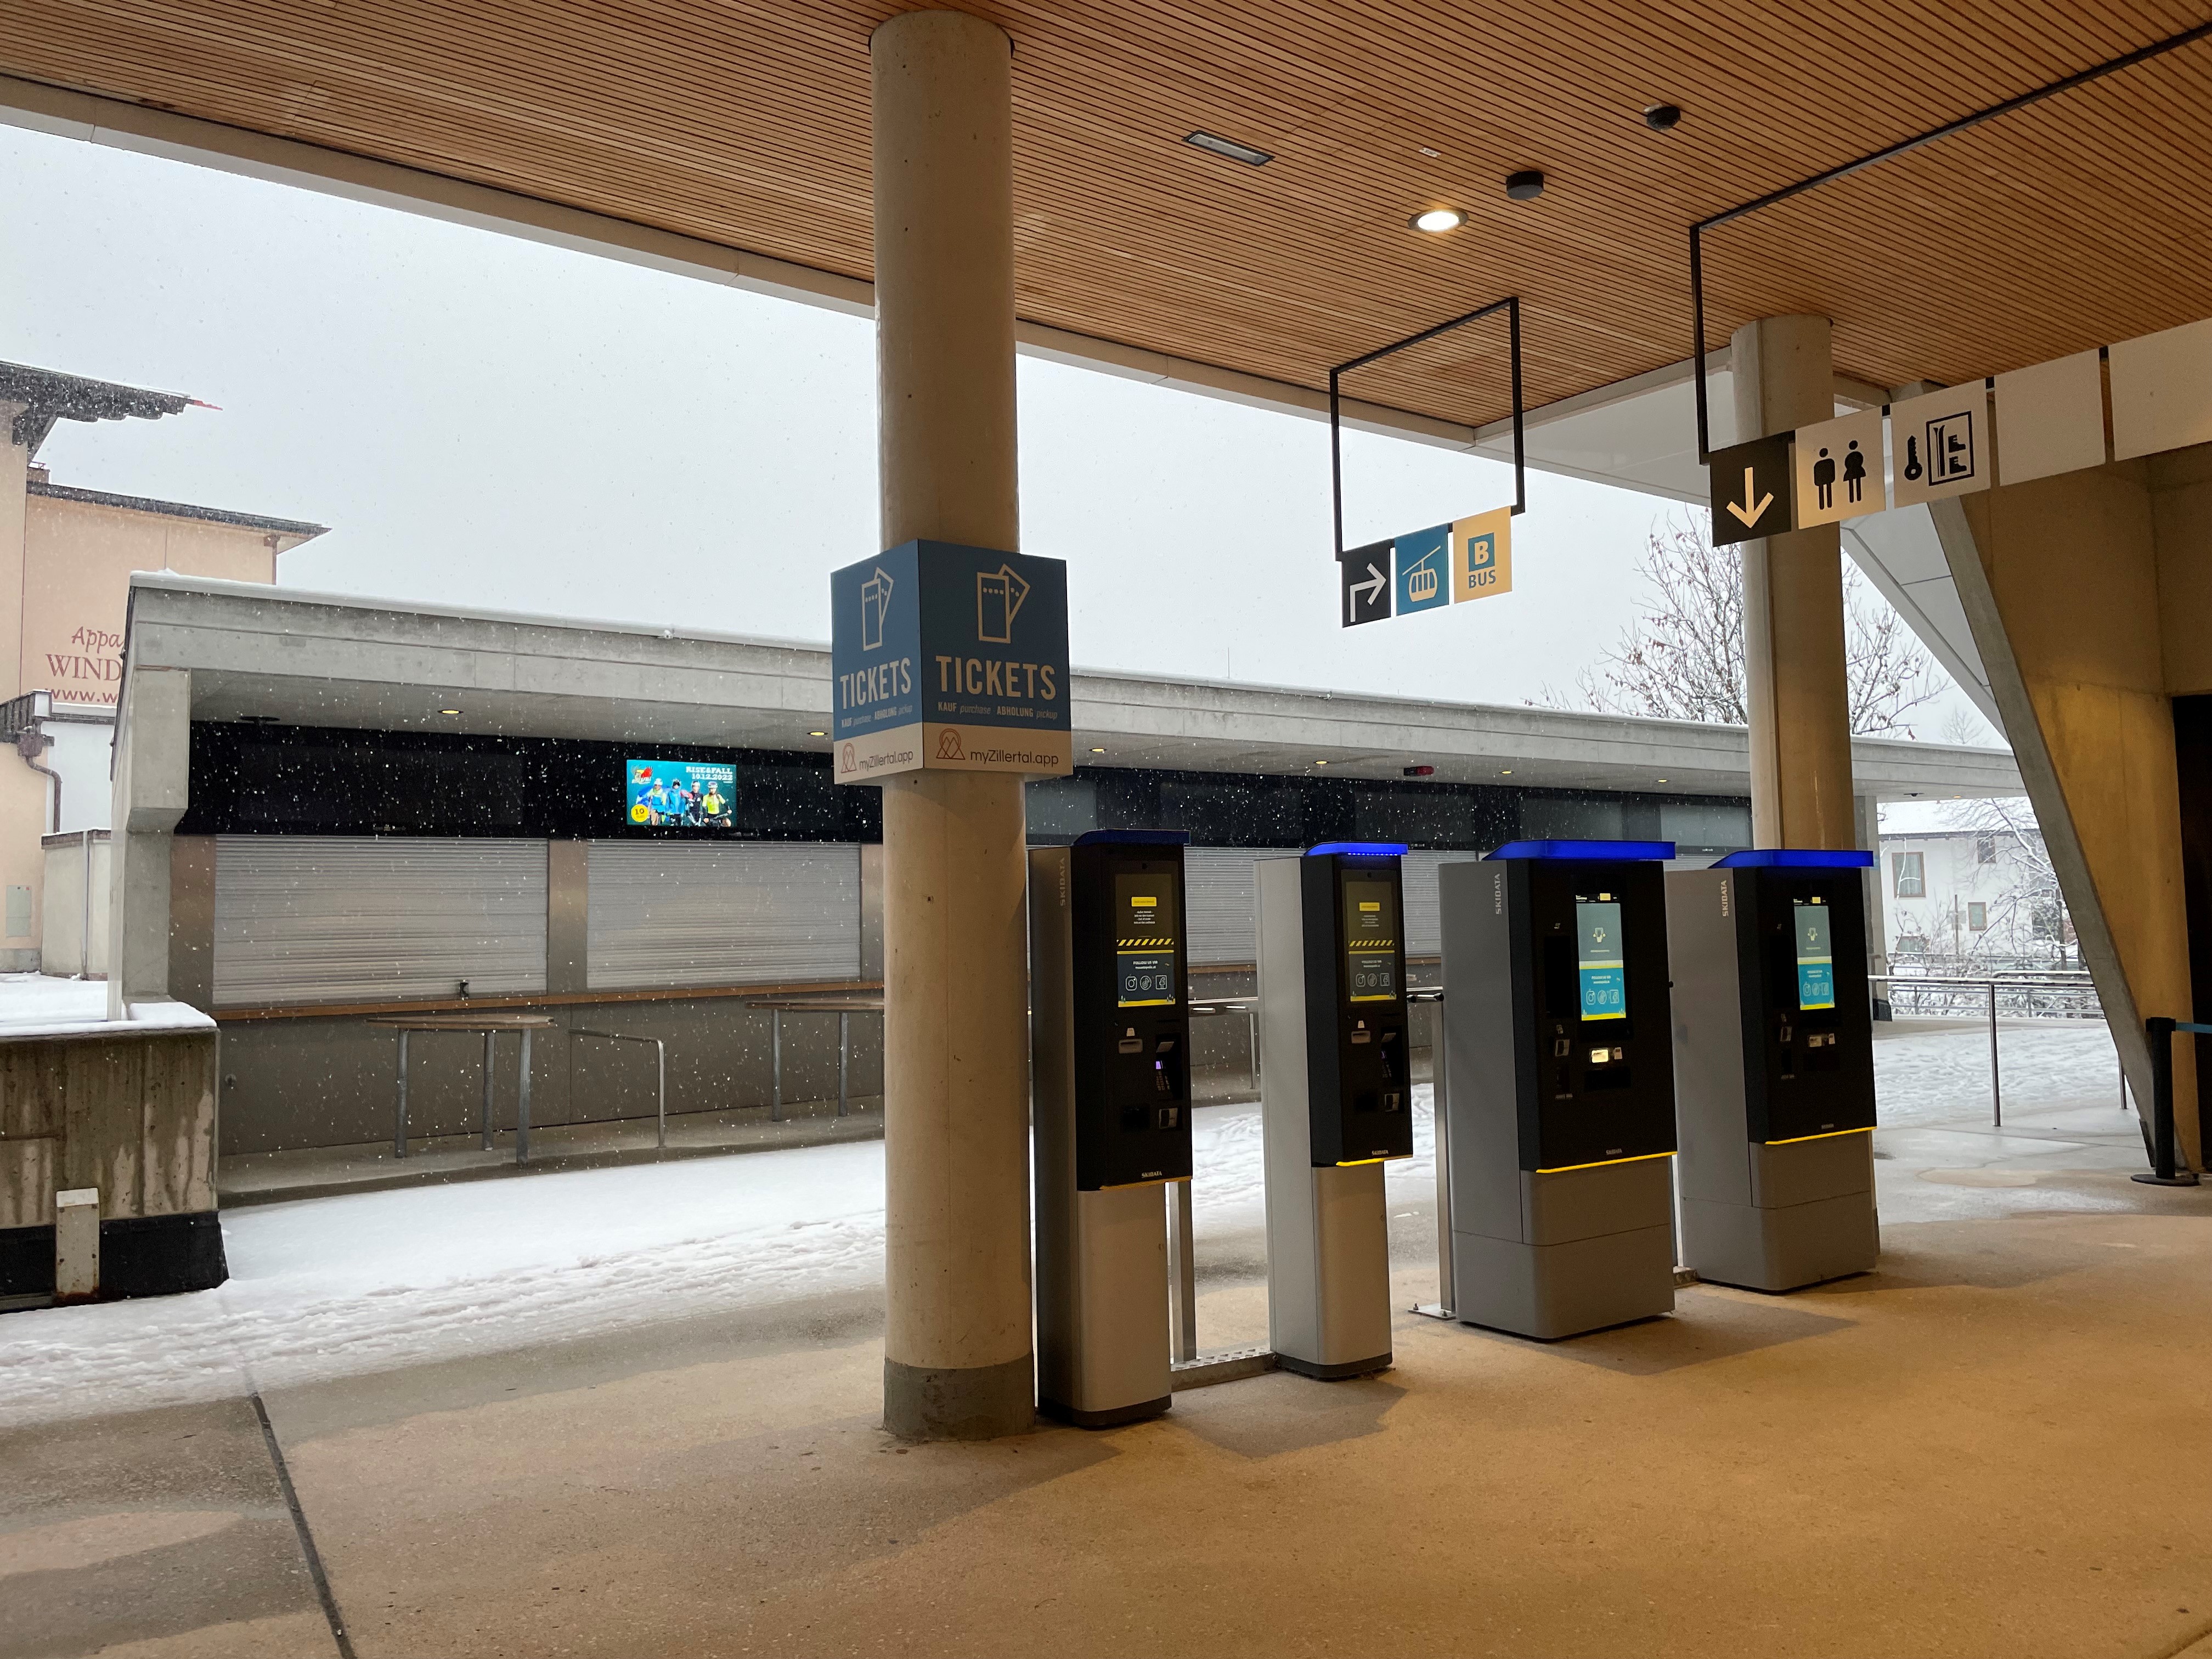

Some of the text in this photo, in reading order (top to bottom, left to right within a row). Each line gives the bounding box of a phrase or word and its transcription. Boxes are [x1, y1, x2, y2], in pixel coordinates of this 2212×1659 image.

[1474, 540, 1489, 565] B
[1469, 569, 1497, 589] BUS
[71, 626, 124, 653] Appa
[45, 654, 122, 681] WIND
[935, 655, 1057, 700] TICKETS
[839, 657, 911, 709] TICKETS
[938, 701, 1058, 720] KAUF purchase ABHOLUNG pickup
[686, 766, 732, 774] RISE&FALL
[859, 750, 913, 771] myZillertal.app
[970, 749, 1059, 767] myZillertal.app
[1493, 873, 1502, 915] SKIDATA
[1720, 879, 1729, 917] SKIDATA
